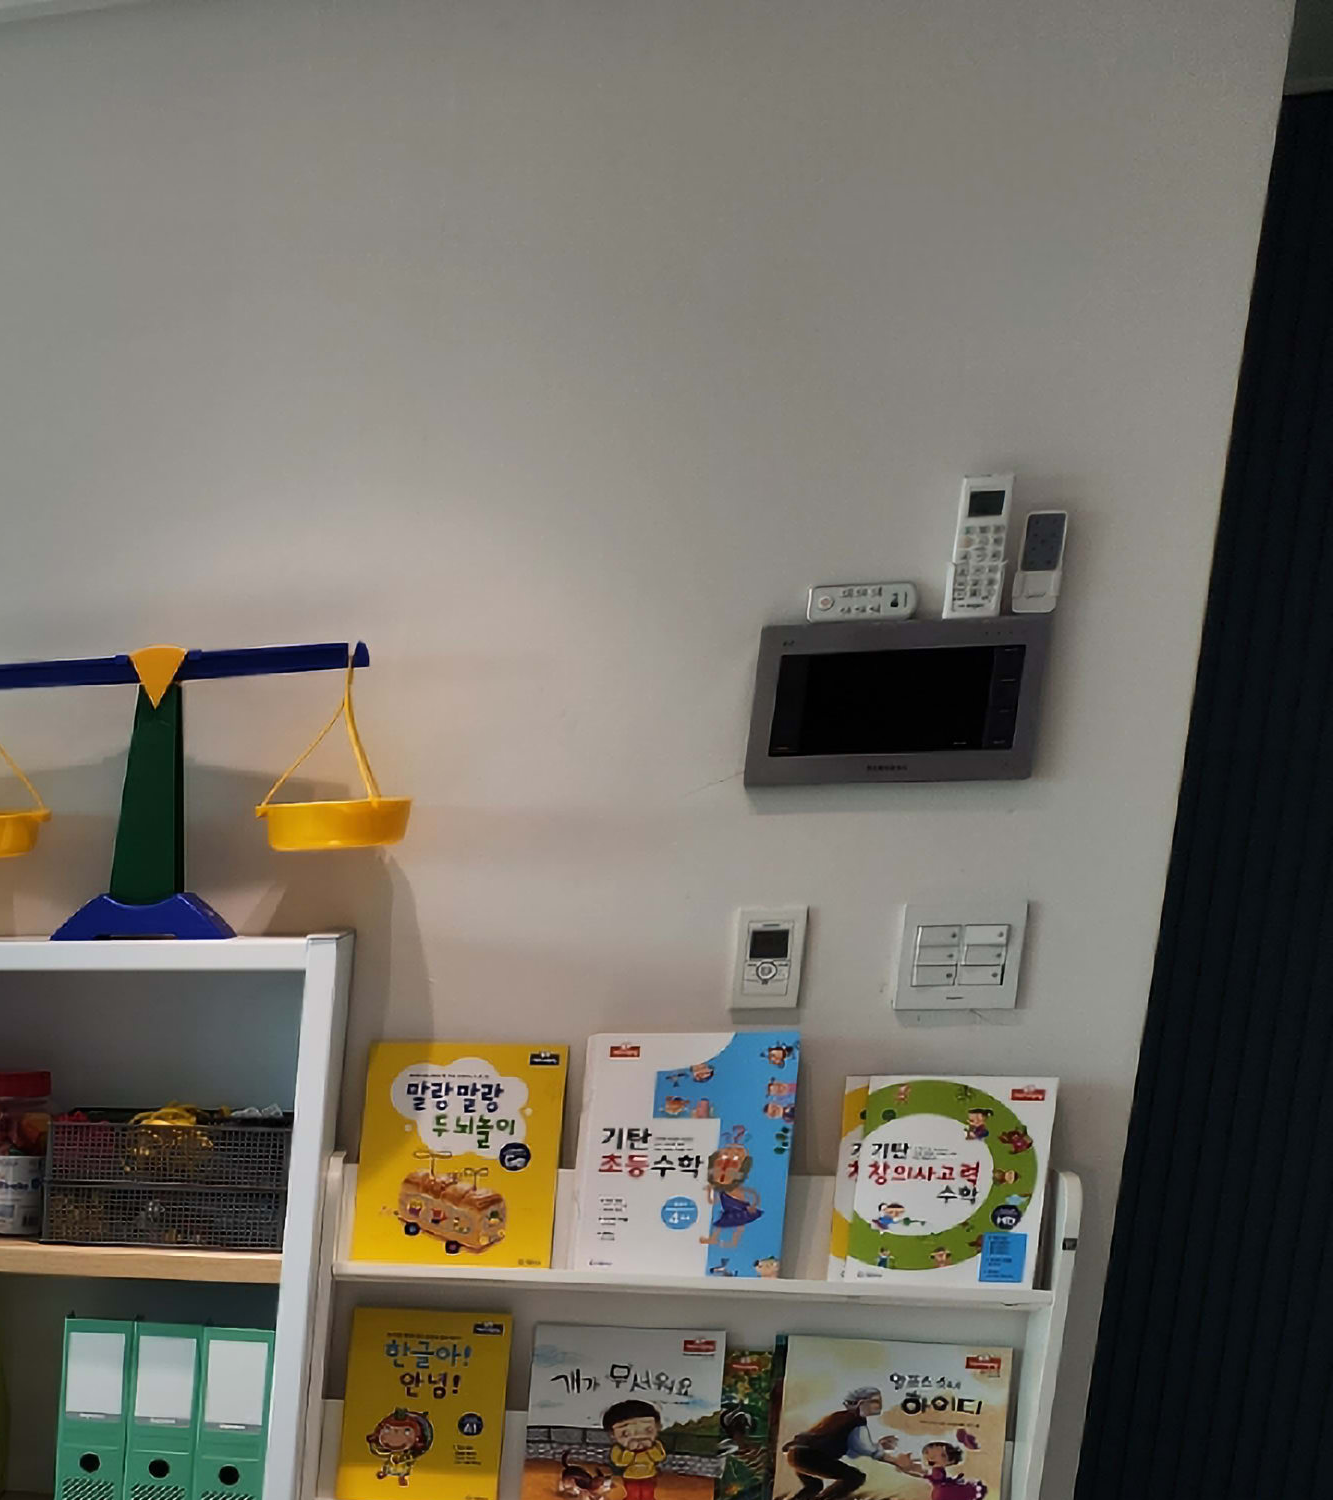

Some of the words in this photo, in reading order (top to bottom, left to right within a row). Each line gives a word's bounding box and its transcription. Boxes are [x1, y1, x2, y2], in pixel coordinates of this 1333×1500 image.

[432, 1113, 516, 1149] 두뇌놀이
[601, 1127, 653, 1150] 기탄
[871, 1142, 910, 1160] 기탄
[868, 1160, 981, 1186] 창의사고력
[937, 1185, 979, 1205] 수학
[385, 1339, 472, 1369] 한글아!
[399, 1371, 461, 1399] 안녕!
[550, 1368, 601, 1394] 개가
[609, 1364, 693, 1397] 무서워요
[900, 1390, 983, 1415] 하이디
